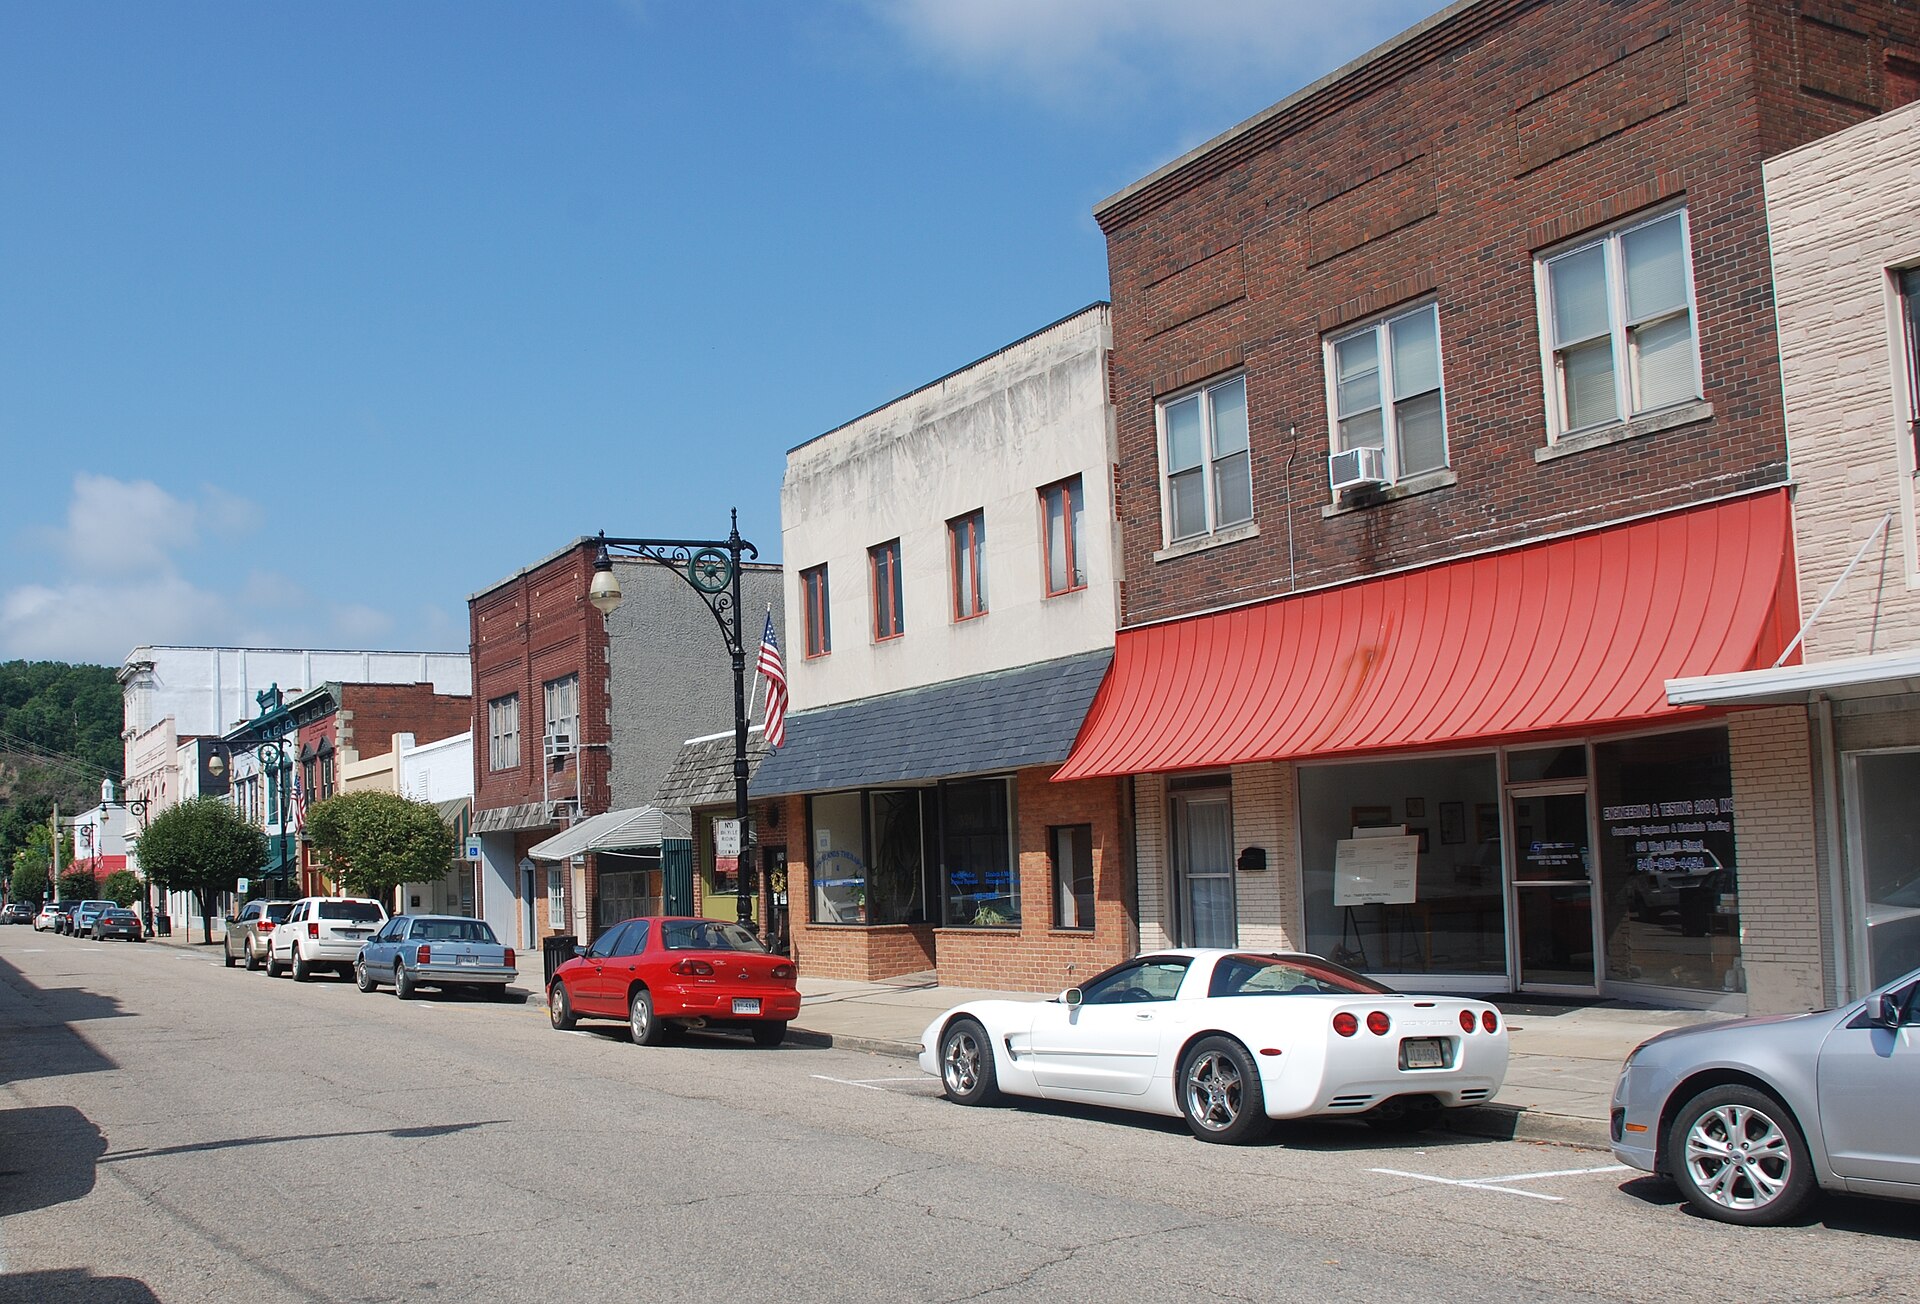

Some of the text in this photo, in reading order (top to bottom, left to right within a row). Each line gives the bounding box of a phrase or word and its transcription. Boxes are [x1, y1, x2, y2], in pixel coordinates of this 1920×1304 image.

[1603, 804, 1650, 820] ENGINEERING
[1652, 804, 1659, 817] &
[1660, 801, 1693, 817] TESTING
[1694, 799, 1719, 816] 2000,
[1611, 826, 1641, 837] Consulting
[1641, 824, 1670, 837] Engineers
[1677, 821, 1706, 833] Materials
[1706, 820, 1730, 832] Testing
[1648, 841, 1665, 852] West
[1665, 840, 1681, 851] Main
[1683, 839, 1704, 851] Street
[1637, 857, 1705, 871] 540-969-4454
